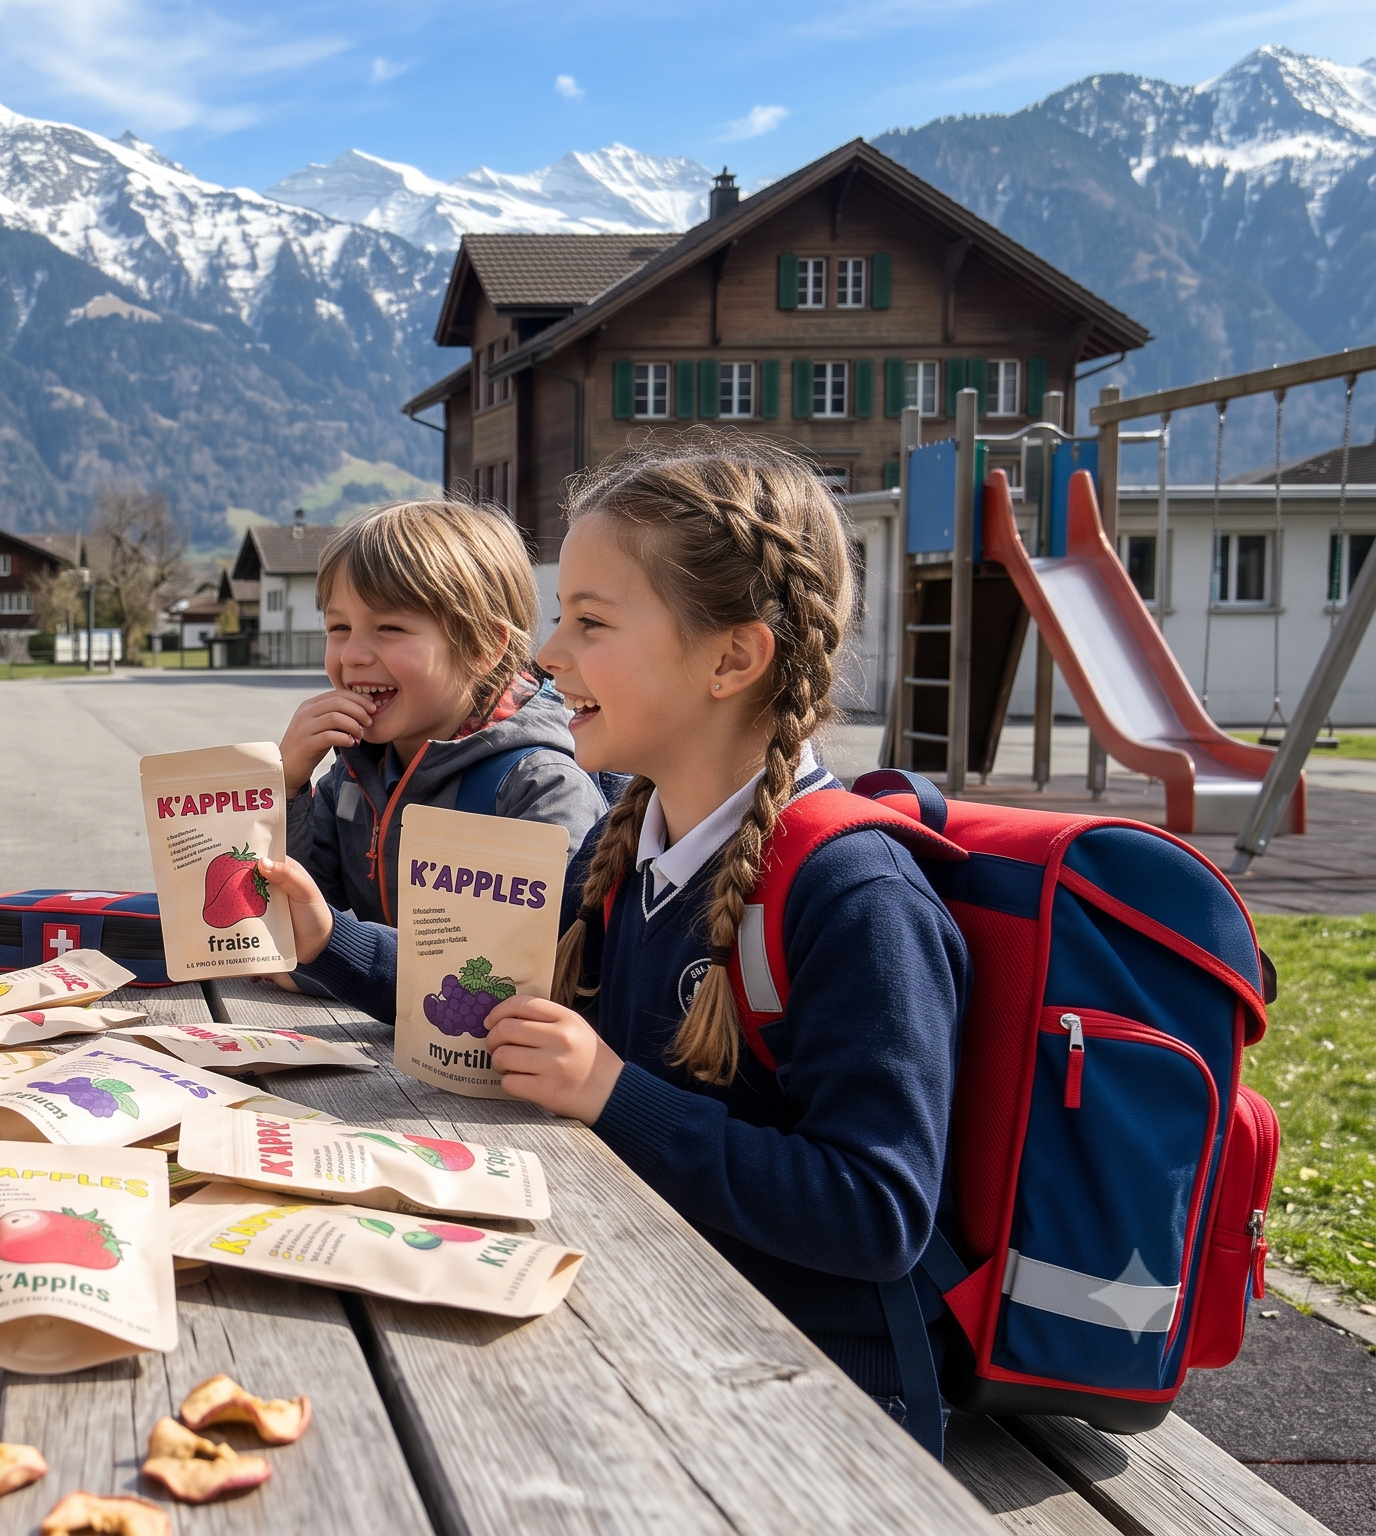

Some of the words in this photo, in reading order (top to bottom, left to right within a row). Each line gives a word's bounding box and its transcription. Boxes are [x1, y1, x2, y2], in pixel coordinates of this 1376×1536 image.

[156, 787, 275, 819] K'APPLES
[410, 859, 547, 910] K'APPLES
[208, 932, 260, 952] fraise
[429, 1042, 491, 1070] myrtill
